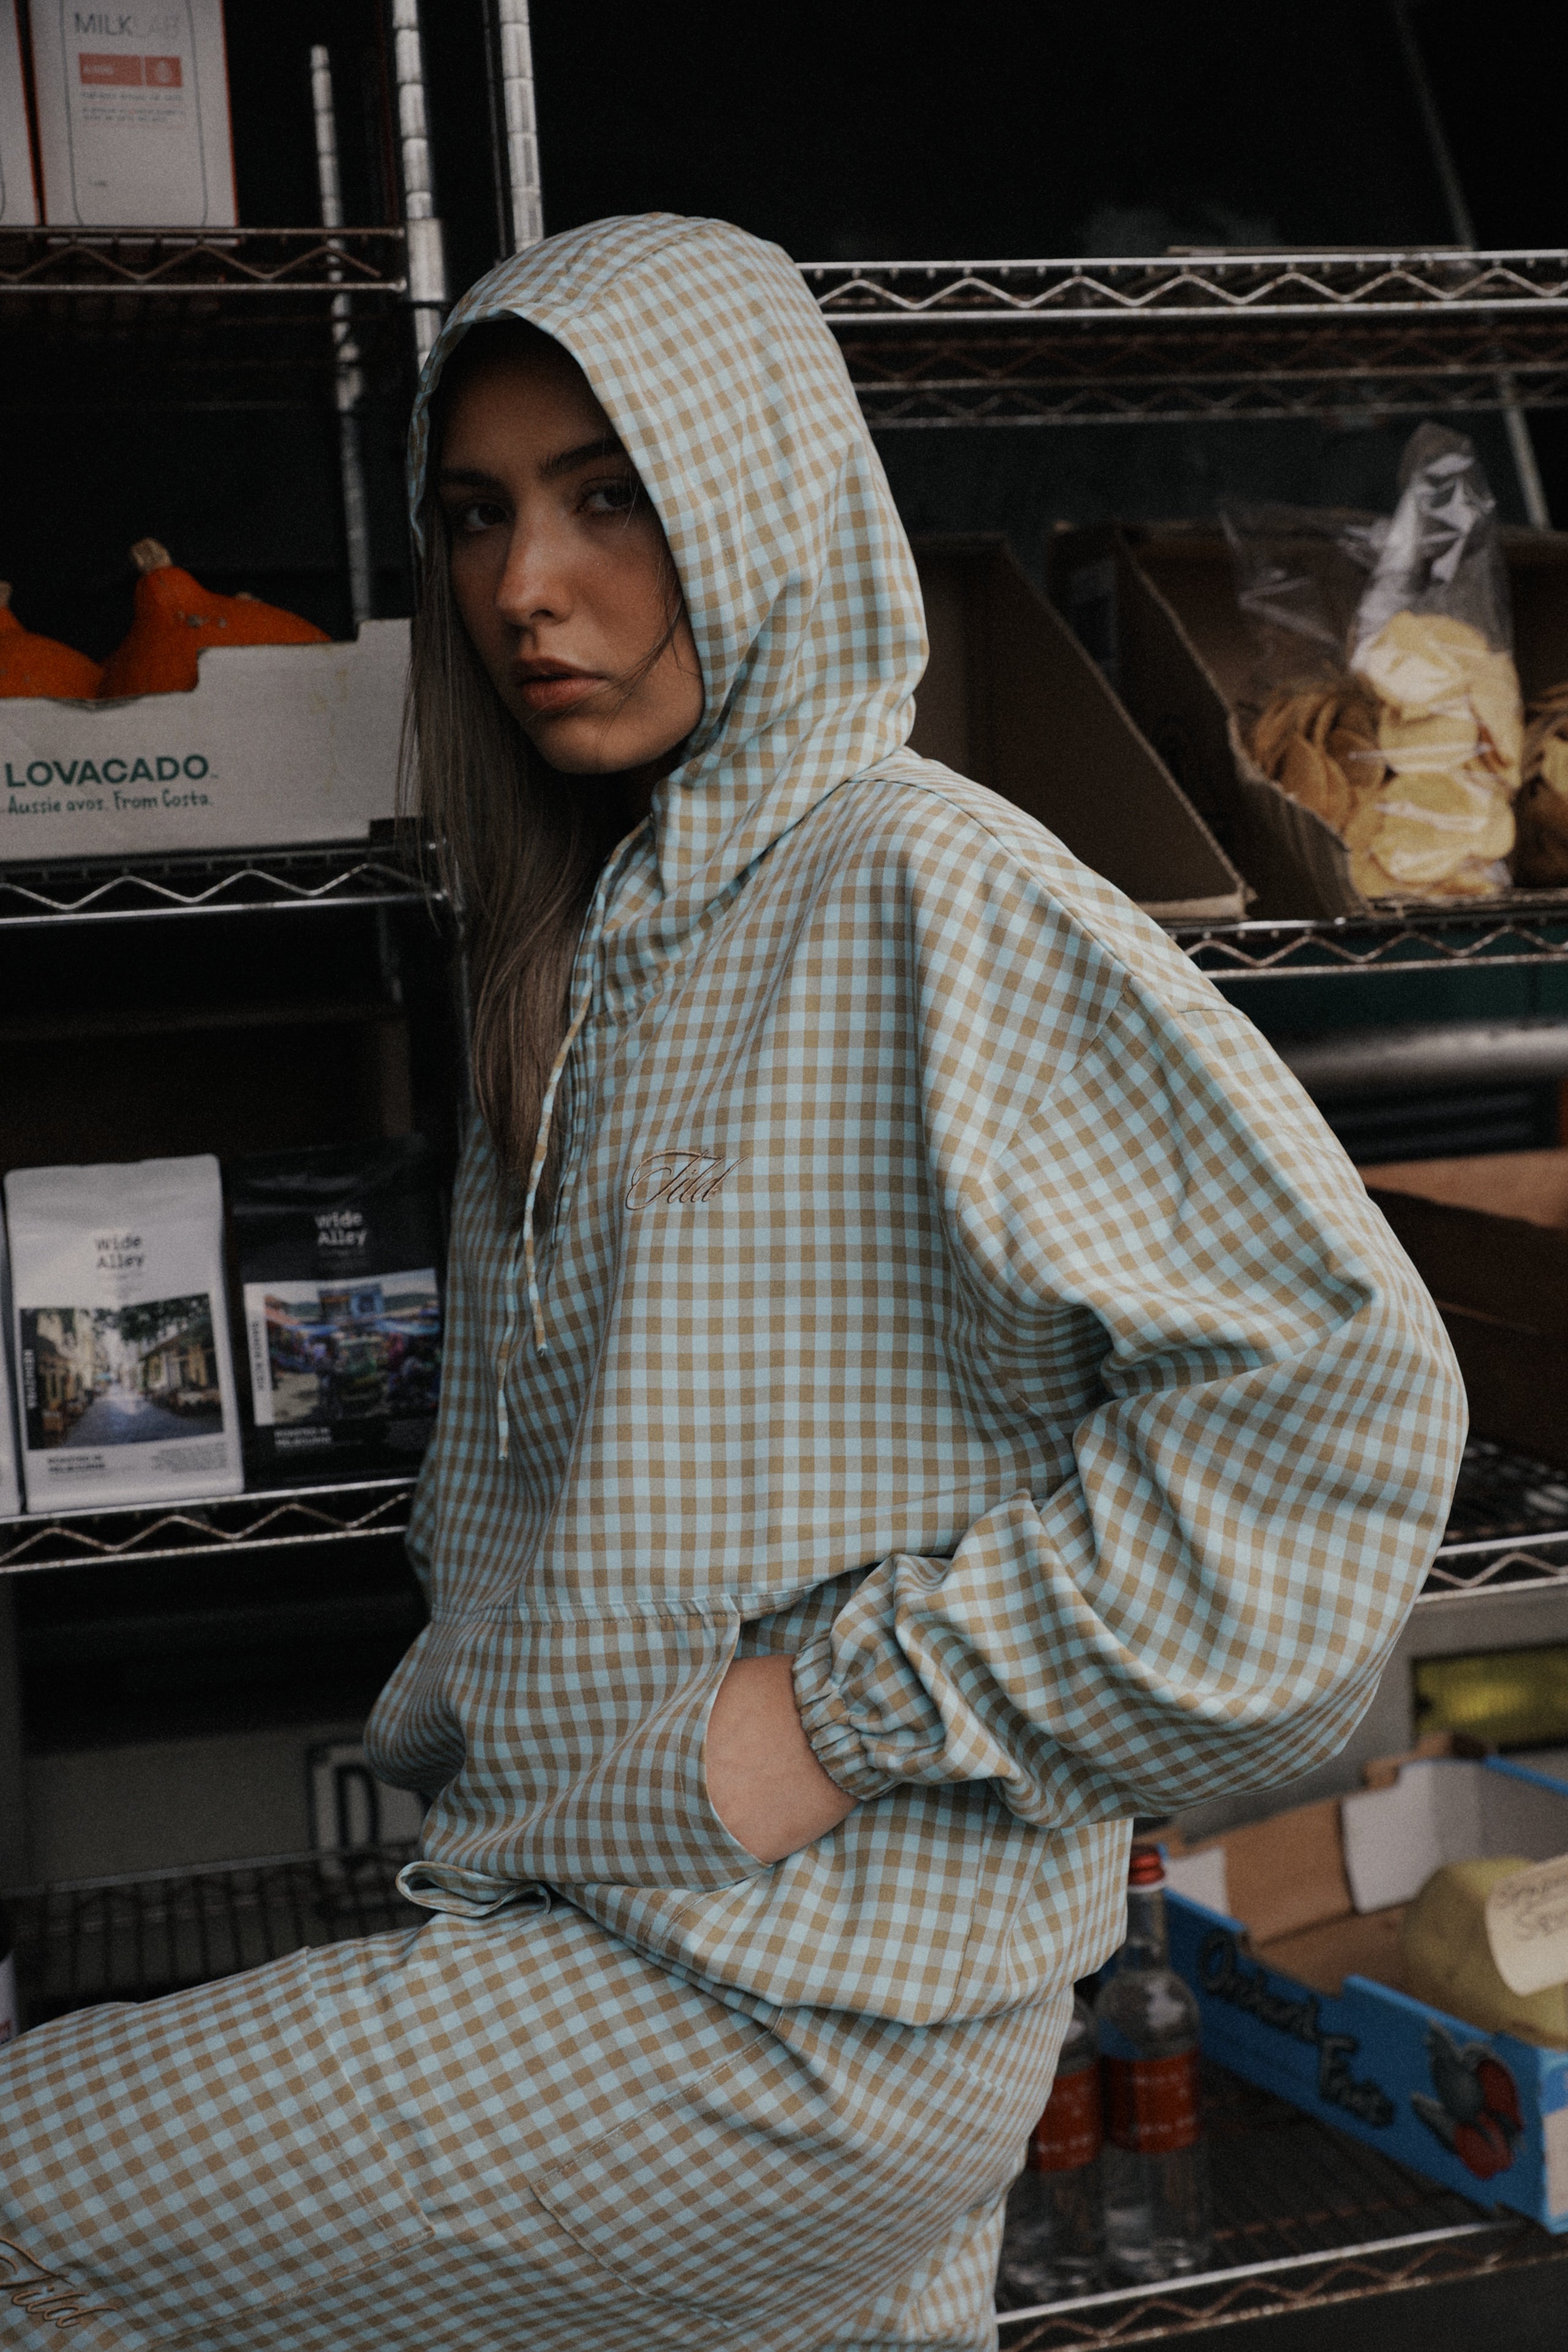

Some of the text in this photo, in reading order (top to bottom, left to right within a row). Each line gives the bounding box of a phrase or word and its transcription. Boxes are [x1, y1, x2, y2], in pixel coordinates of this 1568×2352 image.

[5, 755, 209, 788] LOVACADO
[8, 795, 61, 815] Aussie
[113, 790, 157, 810] From
[315, 1209, 363, 1228] Wide
[95, 1234, 141, 1250] Wide
[318, 1227, 368, 1246] Alley
[97, 1252, 145, 1268] Alley
